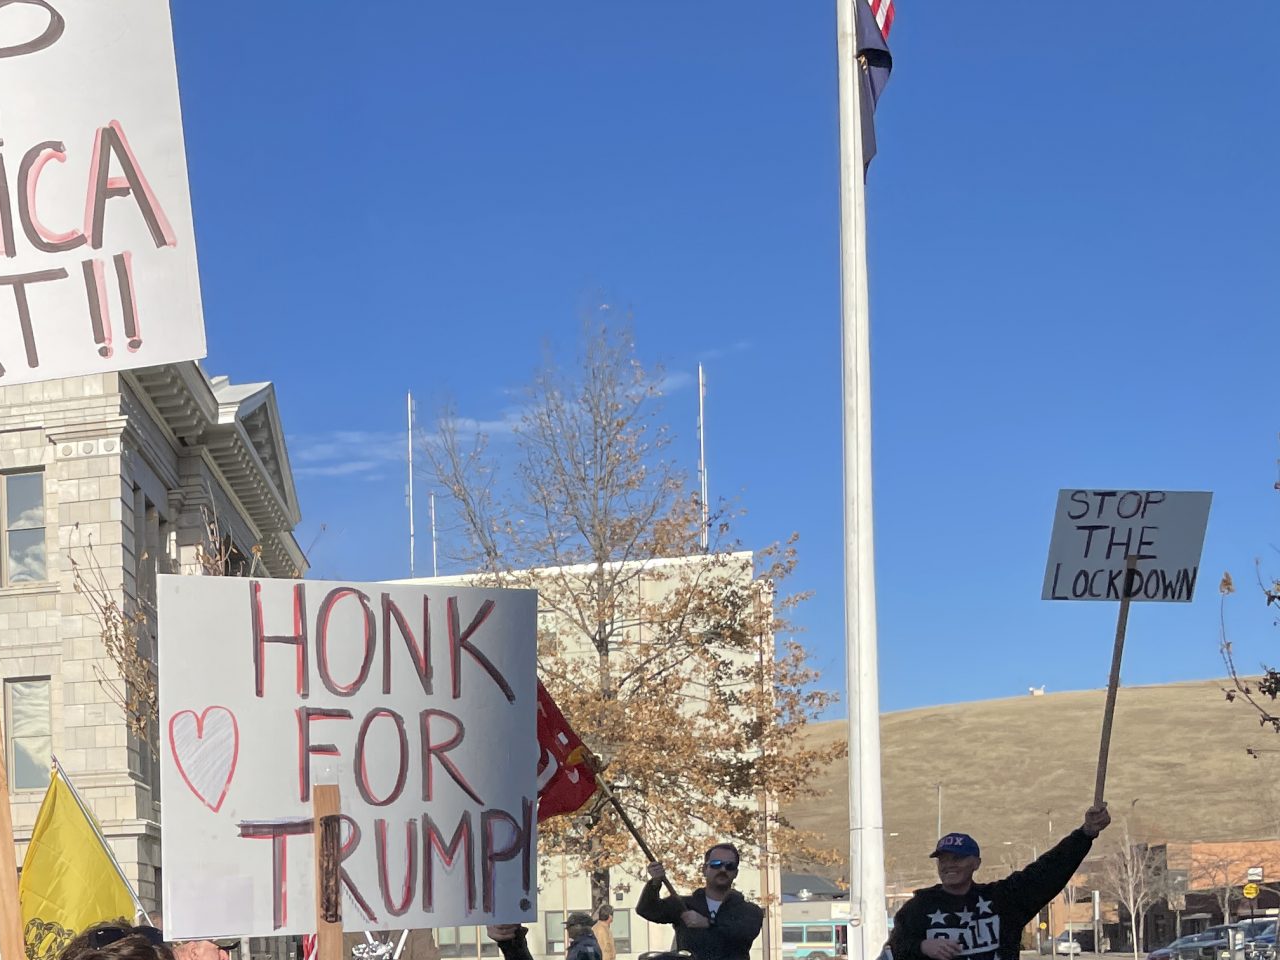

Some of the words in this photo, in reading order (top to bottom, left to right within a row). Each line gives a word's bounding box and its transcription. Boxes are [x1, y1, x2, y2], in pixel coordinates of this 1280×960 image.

[1067, 490, 1166, 520] STOP
[1075, 525, 1159, 560] THE
[1051, 562, 1197, 600] LOCKDOWN
[249, 580, 516, 705] HONK
[295, 705, 485, 806] FOR
[235, 796, 533, 931] TRUMP!
